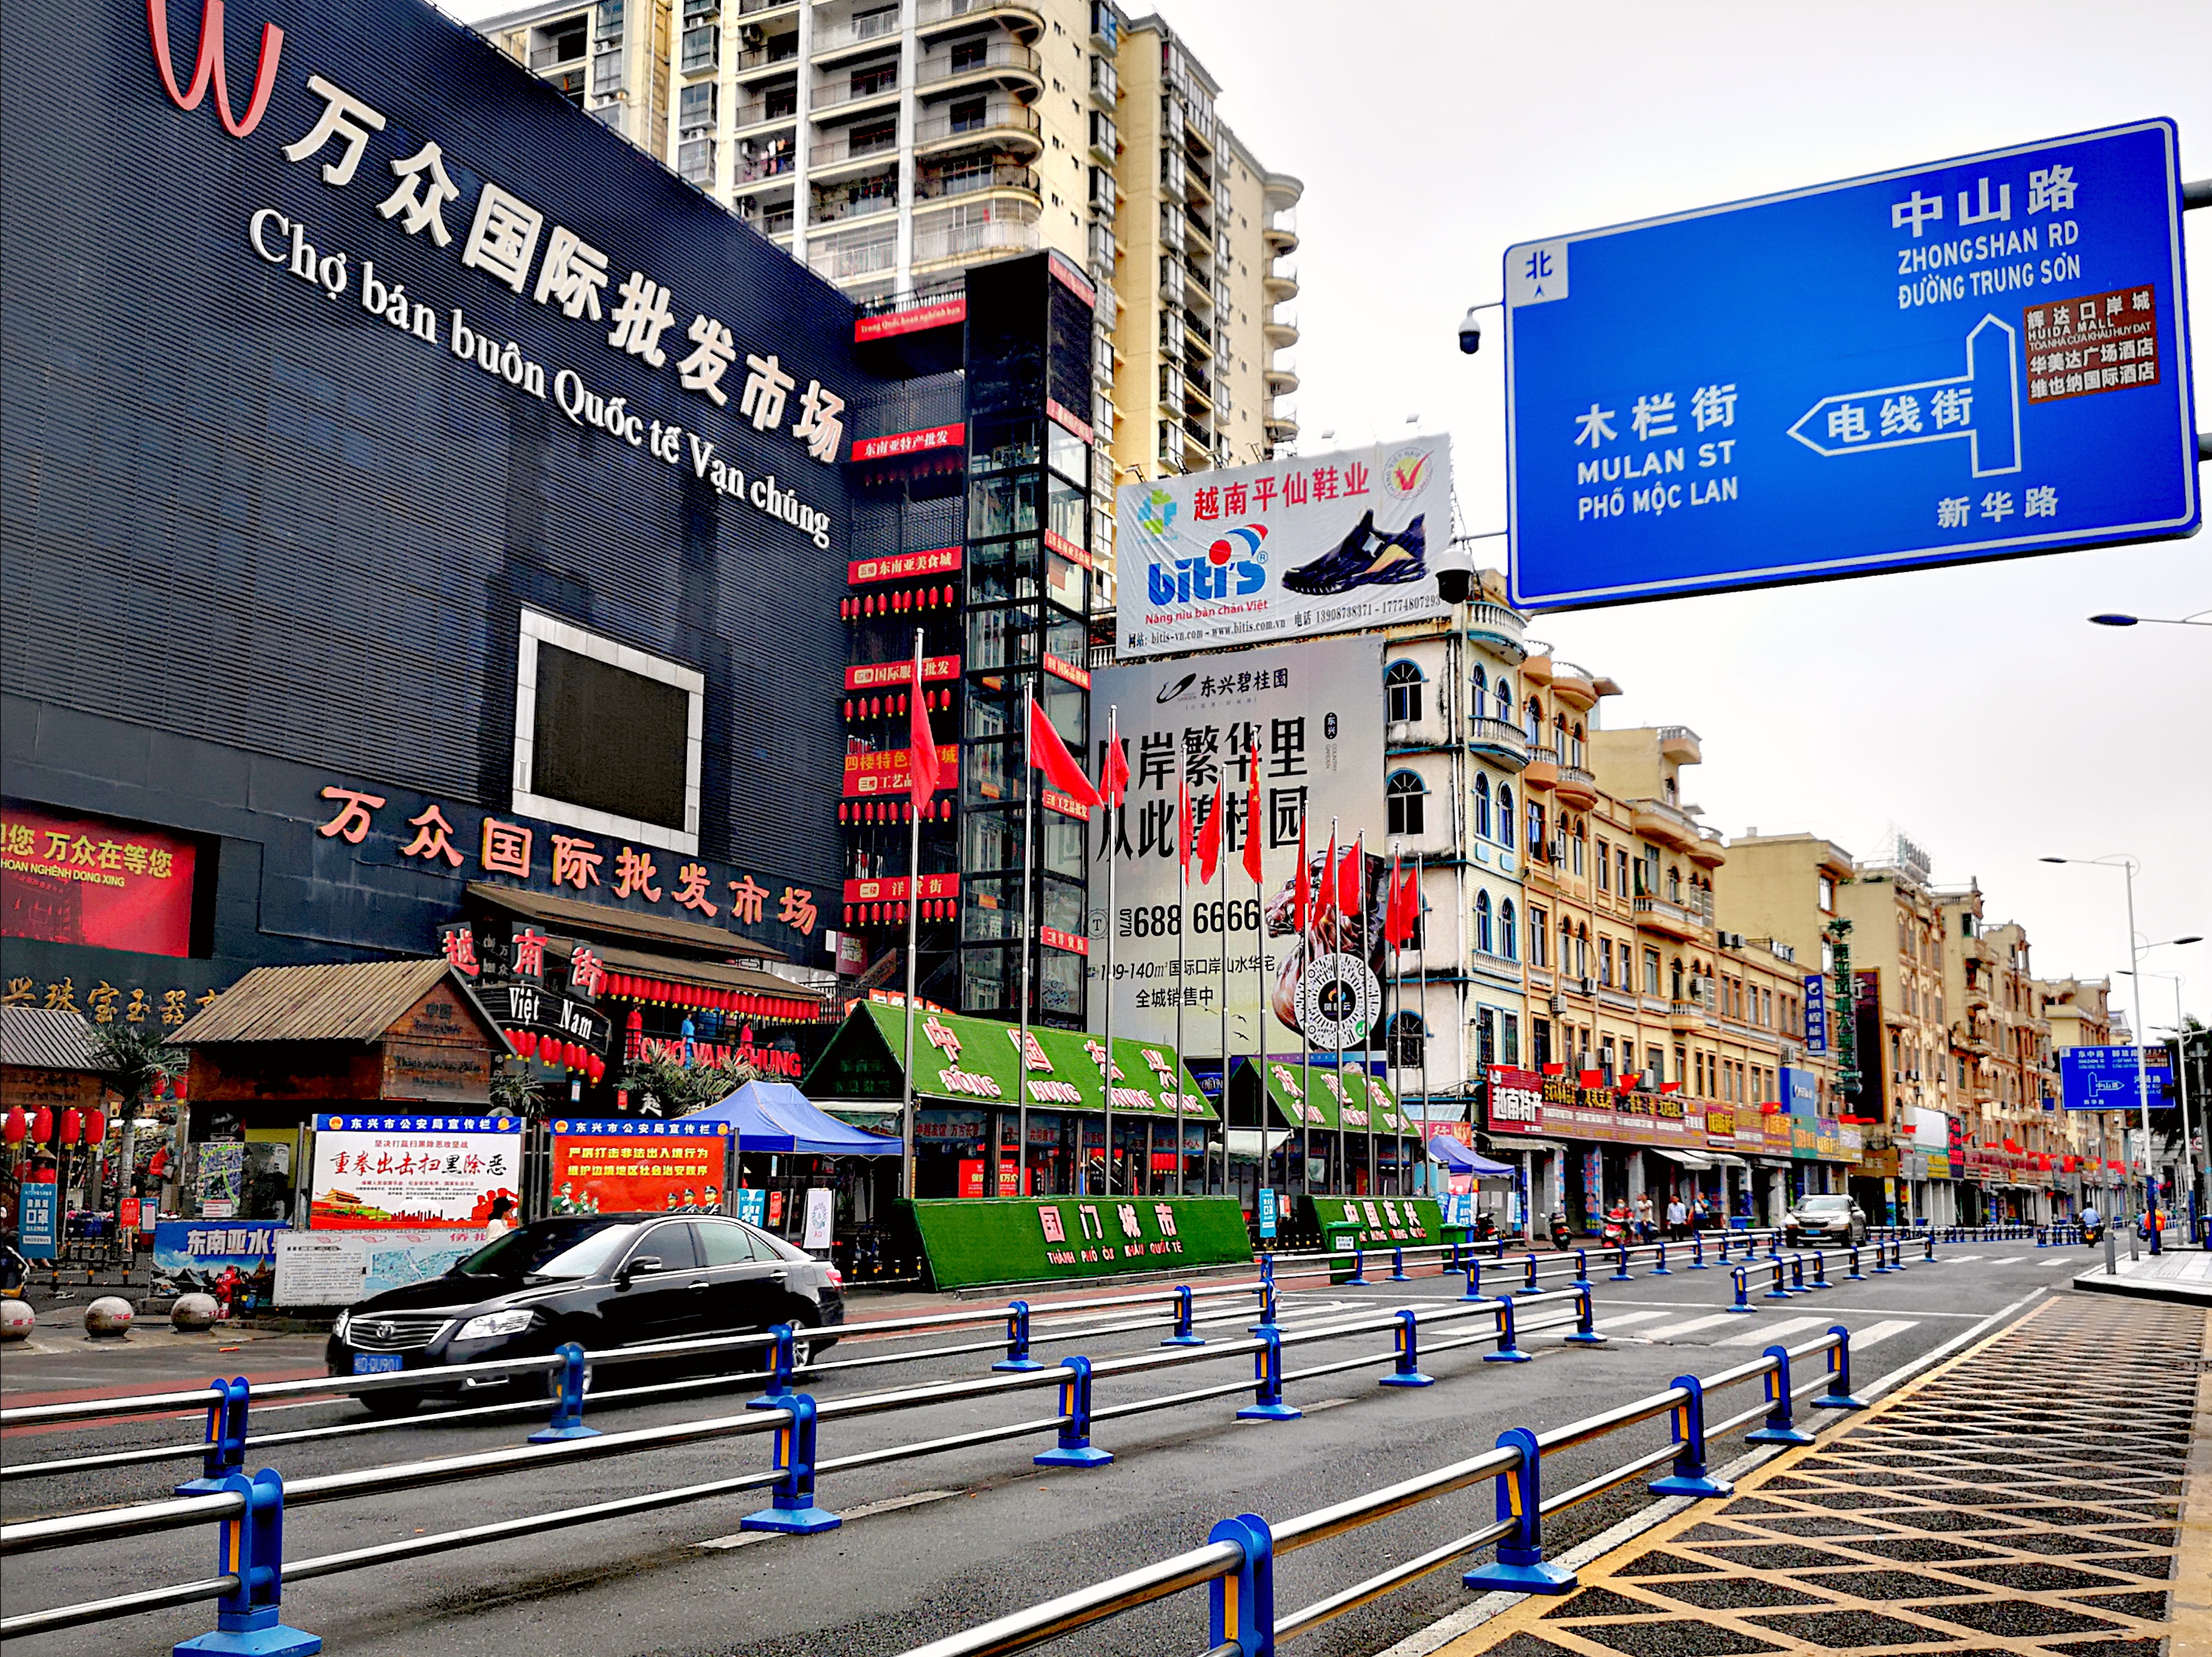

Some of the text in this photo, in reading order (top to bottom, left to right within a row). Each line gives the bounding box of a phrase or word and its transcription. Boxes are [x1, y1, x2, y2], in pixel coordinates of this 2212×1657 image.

[1891, 164, 2079, 238] 中山路
[1525, 250, 1553, 280] 北
[1898, 219, 2079, 275] ZHONGSHAN RD
[280, 75, 846, 463] 万众国际批发市场
[1898, 252, 2081, 309] ĐƯỜNG TRUNG SƠN
[2027, 291, 2151, 330] 辉达口岸城
[2028, 317, 2114, 341] HUIDA MALL
[2113, 326, 2132, 337] HUY
[2030, 336, 2154, 375] 华美达广场酒店
[250, 209, 347, 301] Chợ
[361, 261, 438, 344] bán
[451, 309, 547, 400] buôn
[553, 369, 644, 447] Quốc
[687, 432, 745, 500] Vạn
[750, 475, 831, 550] chúng
[2030, 361, 2155, 398] 维也纳国际酒店
[1574, 383, 1738, 450] 木栏街
[1828, 387, 1974, 443] 电线街
[863, 430, 949, 457] 东南亚特产批发
[1577, 438, 1736, 485] MULAN ST
[1194, 461, 1370, 522] 越南平仙鞋业
[1633, 480, 1682, 516] MỘC
[1690, 476, 1738, 506] LAN
[1937, 485, 2059, 529] 新华路
[879, 552, 952, 576] 东南亚美食城
[1211, 617, 1286, 637] www.bitis.com.vn
[1294, 611, 1312, 627] 电话
[1247, 599, 1268, 614] Việt
[845, 746, 957, 772] 四楼特色城
[0, 823, 173, 879] 您 万众在等您
[318, 786, 818, 936] 万众国际批发市场
[73, 870, 101, 884] DONG
[102, 875, 125, 887] XING
[1119, 899, 1260, 937] 0770 688 6666
[442, 927, 604, 997] 越南街
[509, 987, 540, 1026] Việt
[558, 998, 593, 1040] Nam
[1136, 986, 1214, 1008] 全城销售中
[351, 1118, 491, 1130] 东兴市公安局宣传栏
[575, 1122, 711, 1135] 东兴市公安局宣传栏
[330, 1150, 508, 1177] 重拳出击扫黑除恶
[375, 1140, 469, 1149] 坚决打赢扫黑除恶攻坚战
[568, 1147, 709, 1159] 严厉打击非法出入境行为
[567, 1165, 708, 1176] 维护边境地区社会治安秩序
[1037, 1202, 1178, 1243] 国门城市
[187, 1229, 278, 1256] 东南亚水
